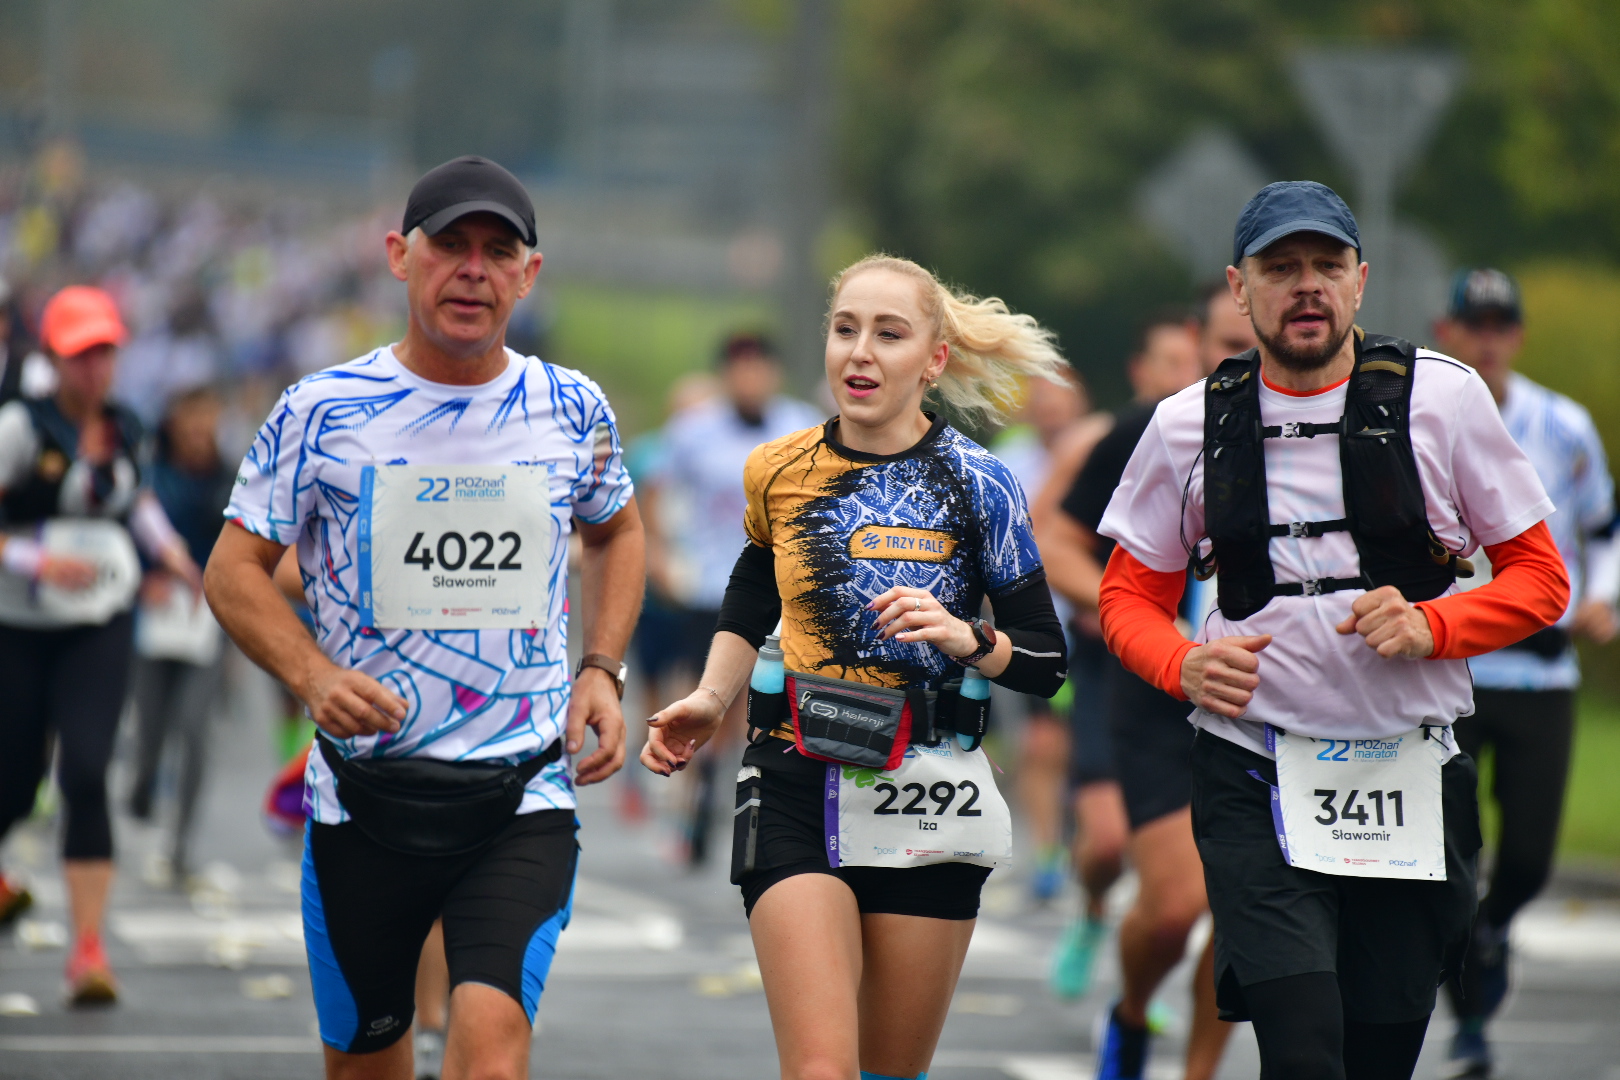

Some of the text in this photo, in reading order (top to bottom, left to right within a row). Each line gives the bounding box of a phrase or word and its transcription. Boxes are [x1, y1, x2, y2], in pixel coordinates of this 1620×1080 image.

[415, 477, 450, 502] 22
[455, 488, 505, 498] maraton
[403, 531, 522, 571] 4022
[885, 535, 945, 554] TRZY FALE
[432, 575, 497, 588] Sławomir
[1316, 738, 1350, 761] 22
[1354, 749, 1398, 759] maraton
[873, 780, 982, 817] 2292
[1314, 788, 1404, 827] 3411
[919, 819, 938, 831] Iza
[829, 835, 838, 851] K30
[1331, 829, 1391, 842] Sławomir
